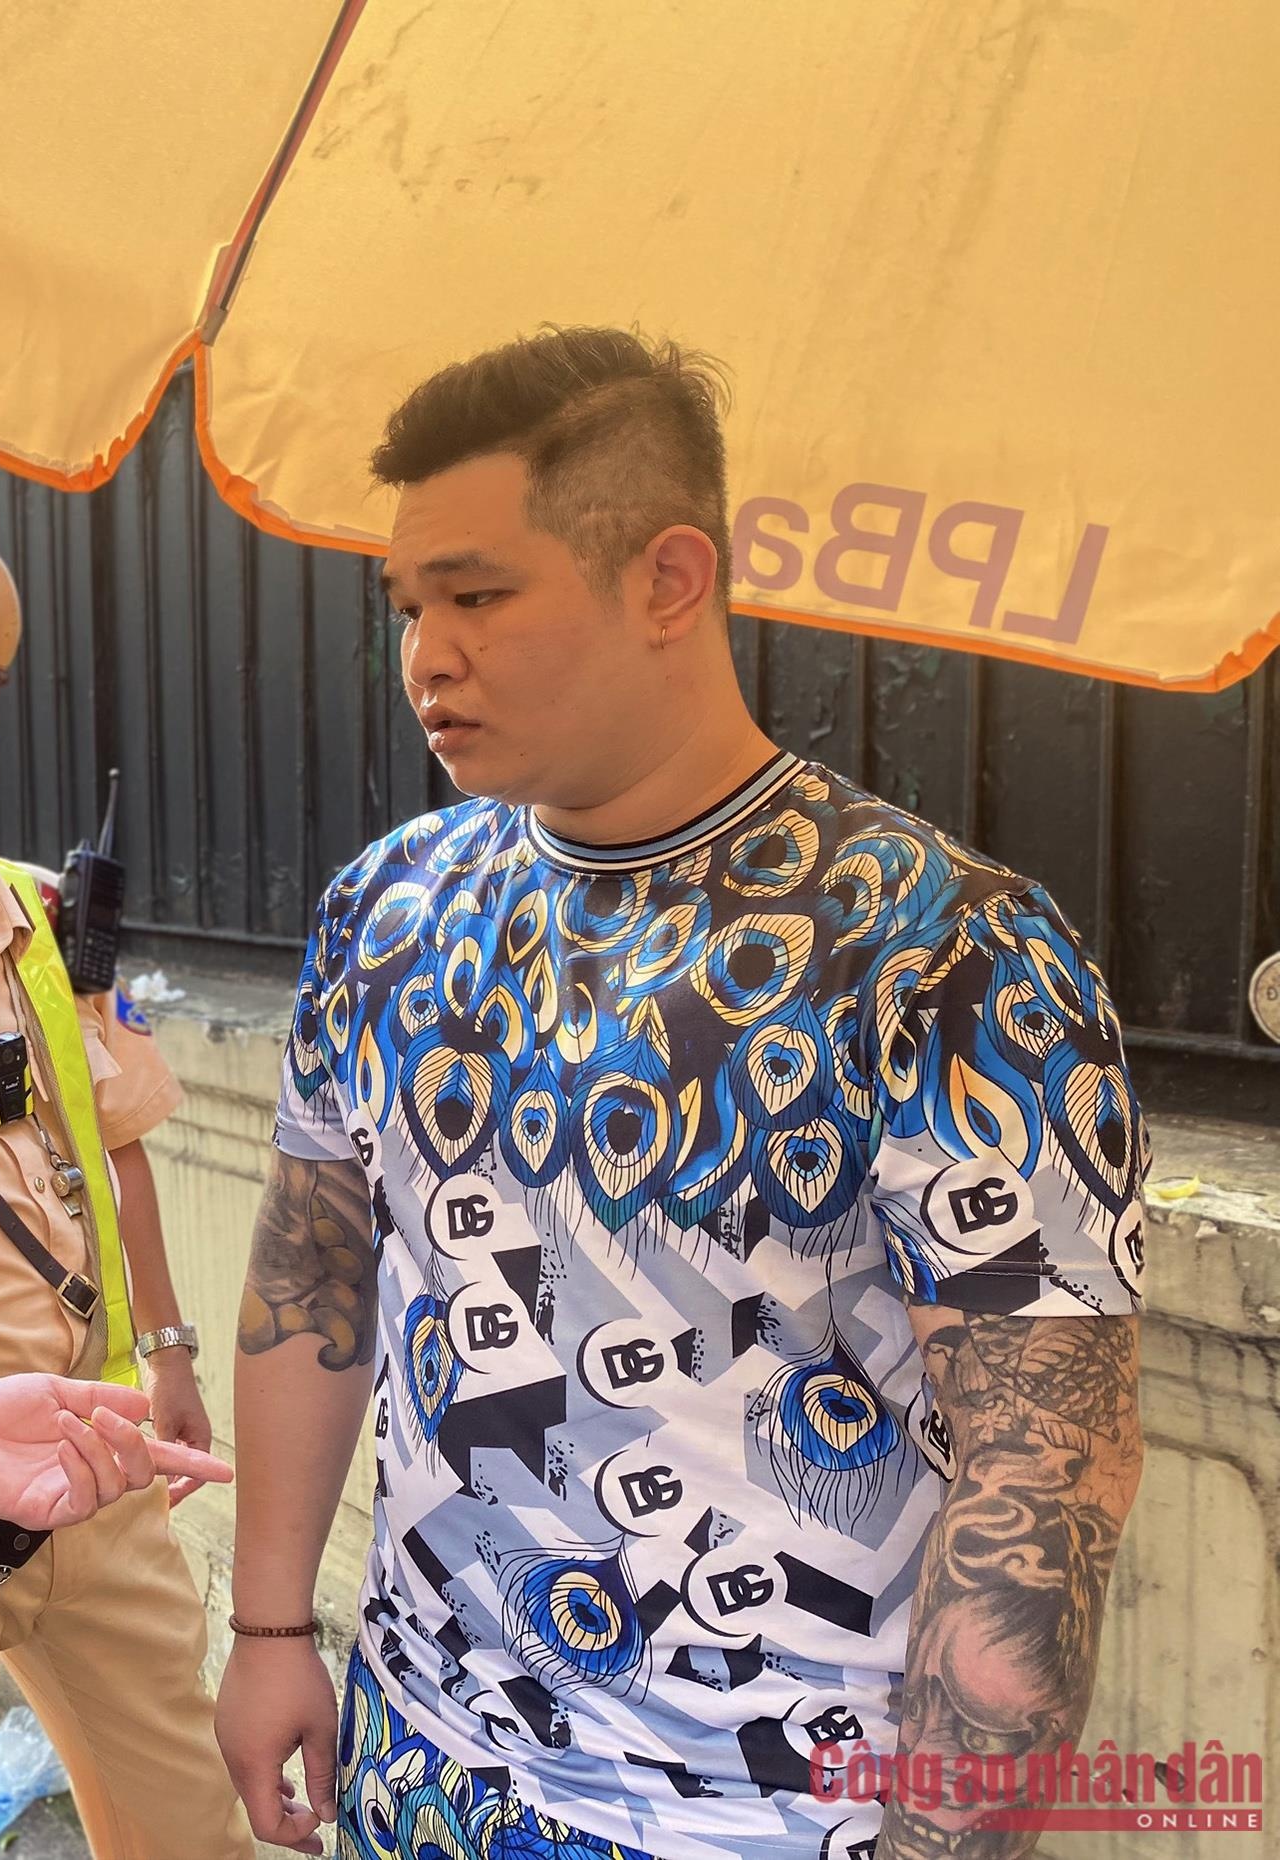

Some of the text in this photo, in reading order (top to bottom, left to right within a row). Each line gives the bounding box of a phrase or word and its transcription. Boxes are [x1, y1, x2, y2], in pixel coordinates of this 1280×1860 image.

[447, 1194, 494, 1240] DG
[948, 1177, 1018, 1235] DG
[465, 1303, 518, 1352] DG
[601, 1338, 664, 1390] DG
[618, 1465, 683, 1518] DG
[706, 1564, 774, 1617] DG
